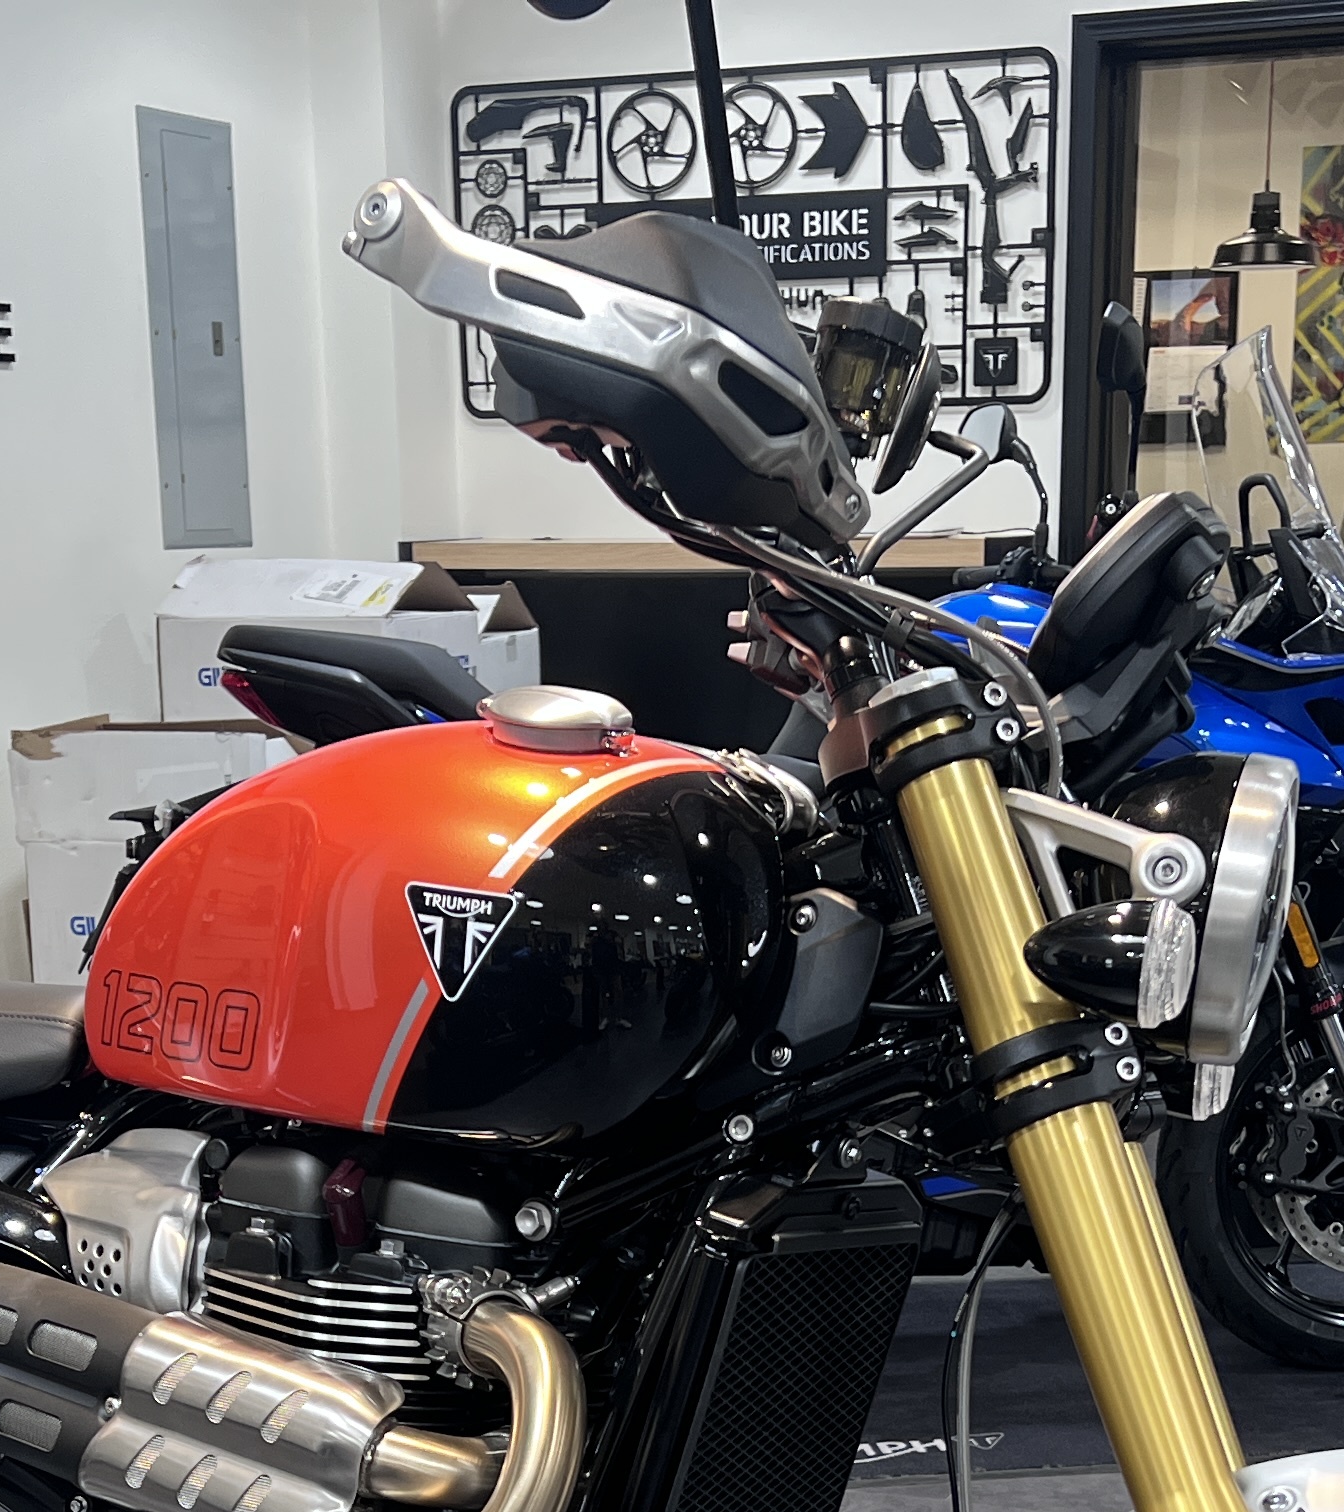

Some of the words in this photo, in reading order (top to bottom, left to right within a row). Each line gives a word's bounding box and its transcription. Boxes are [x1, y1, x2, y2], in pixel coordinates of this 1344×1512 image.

[802, 209, 869, 238] BIKE
[757, 240, 870, 264] IFICATIONS
[423, 891, 493, 917] TRIUMPH
[101, 969, 261, 1071] 1200
